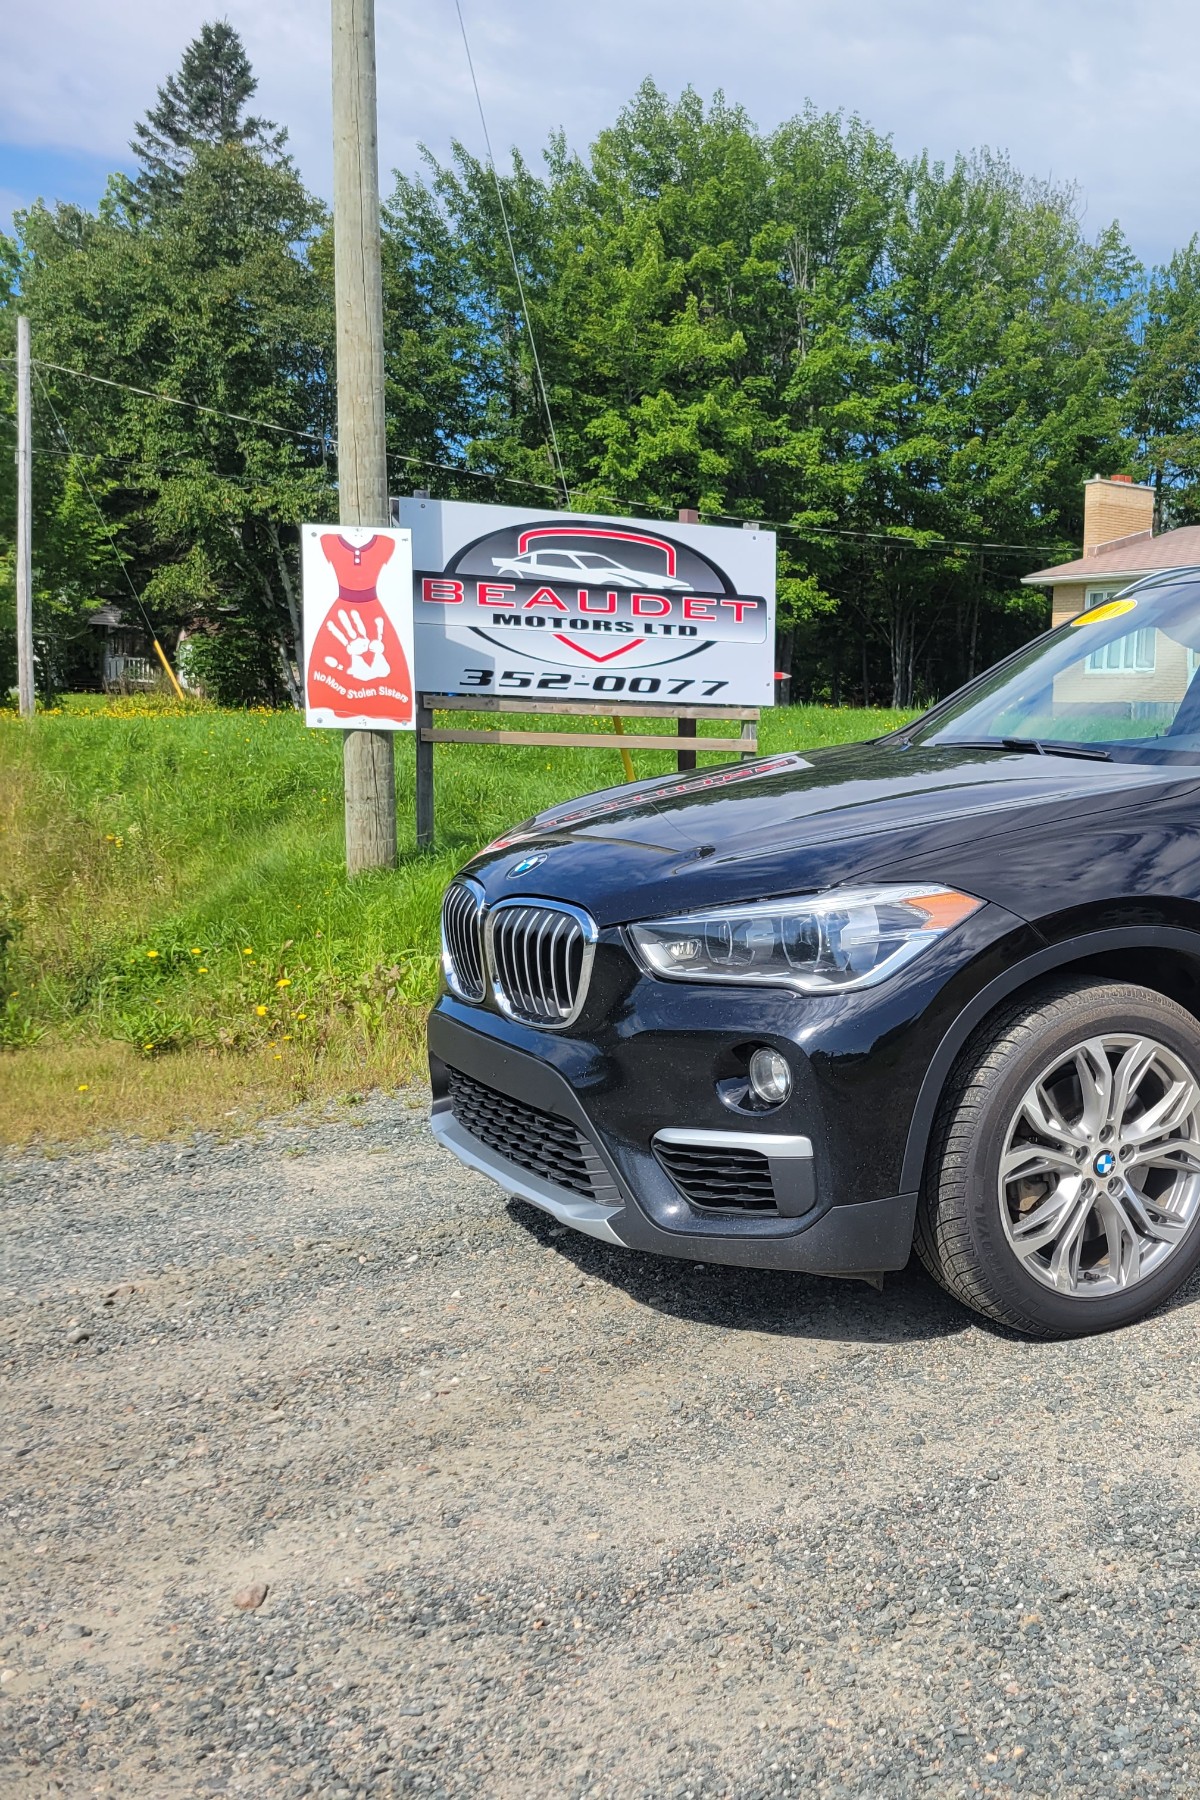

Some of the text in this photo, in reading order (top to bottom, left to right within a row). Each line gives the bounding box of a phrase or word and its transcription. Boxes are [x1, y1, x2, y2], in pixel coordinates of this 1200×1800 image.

[421, 578, 758, 623] BEAUDET
[492, 613, 698, 637] MOTORS LTD
[313, 670, 409, 703] No More Stolen Sisters
[458, 668, 730, 697] 352-0077
